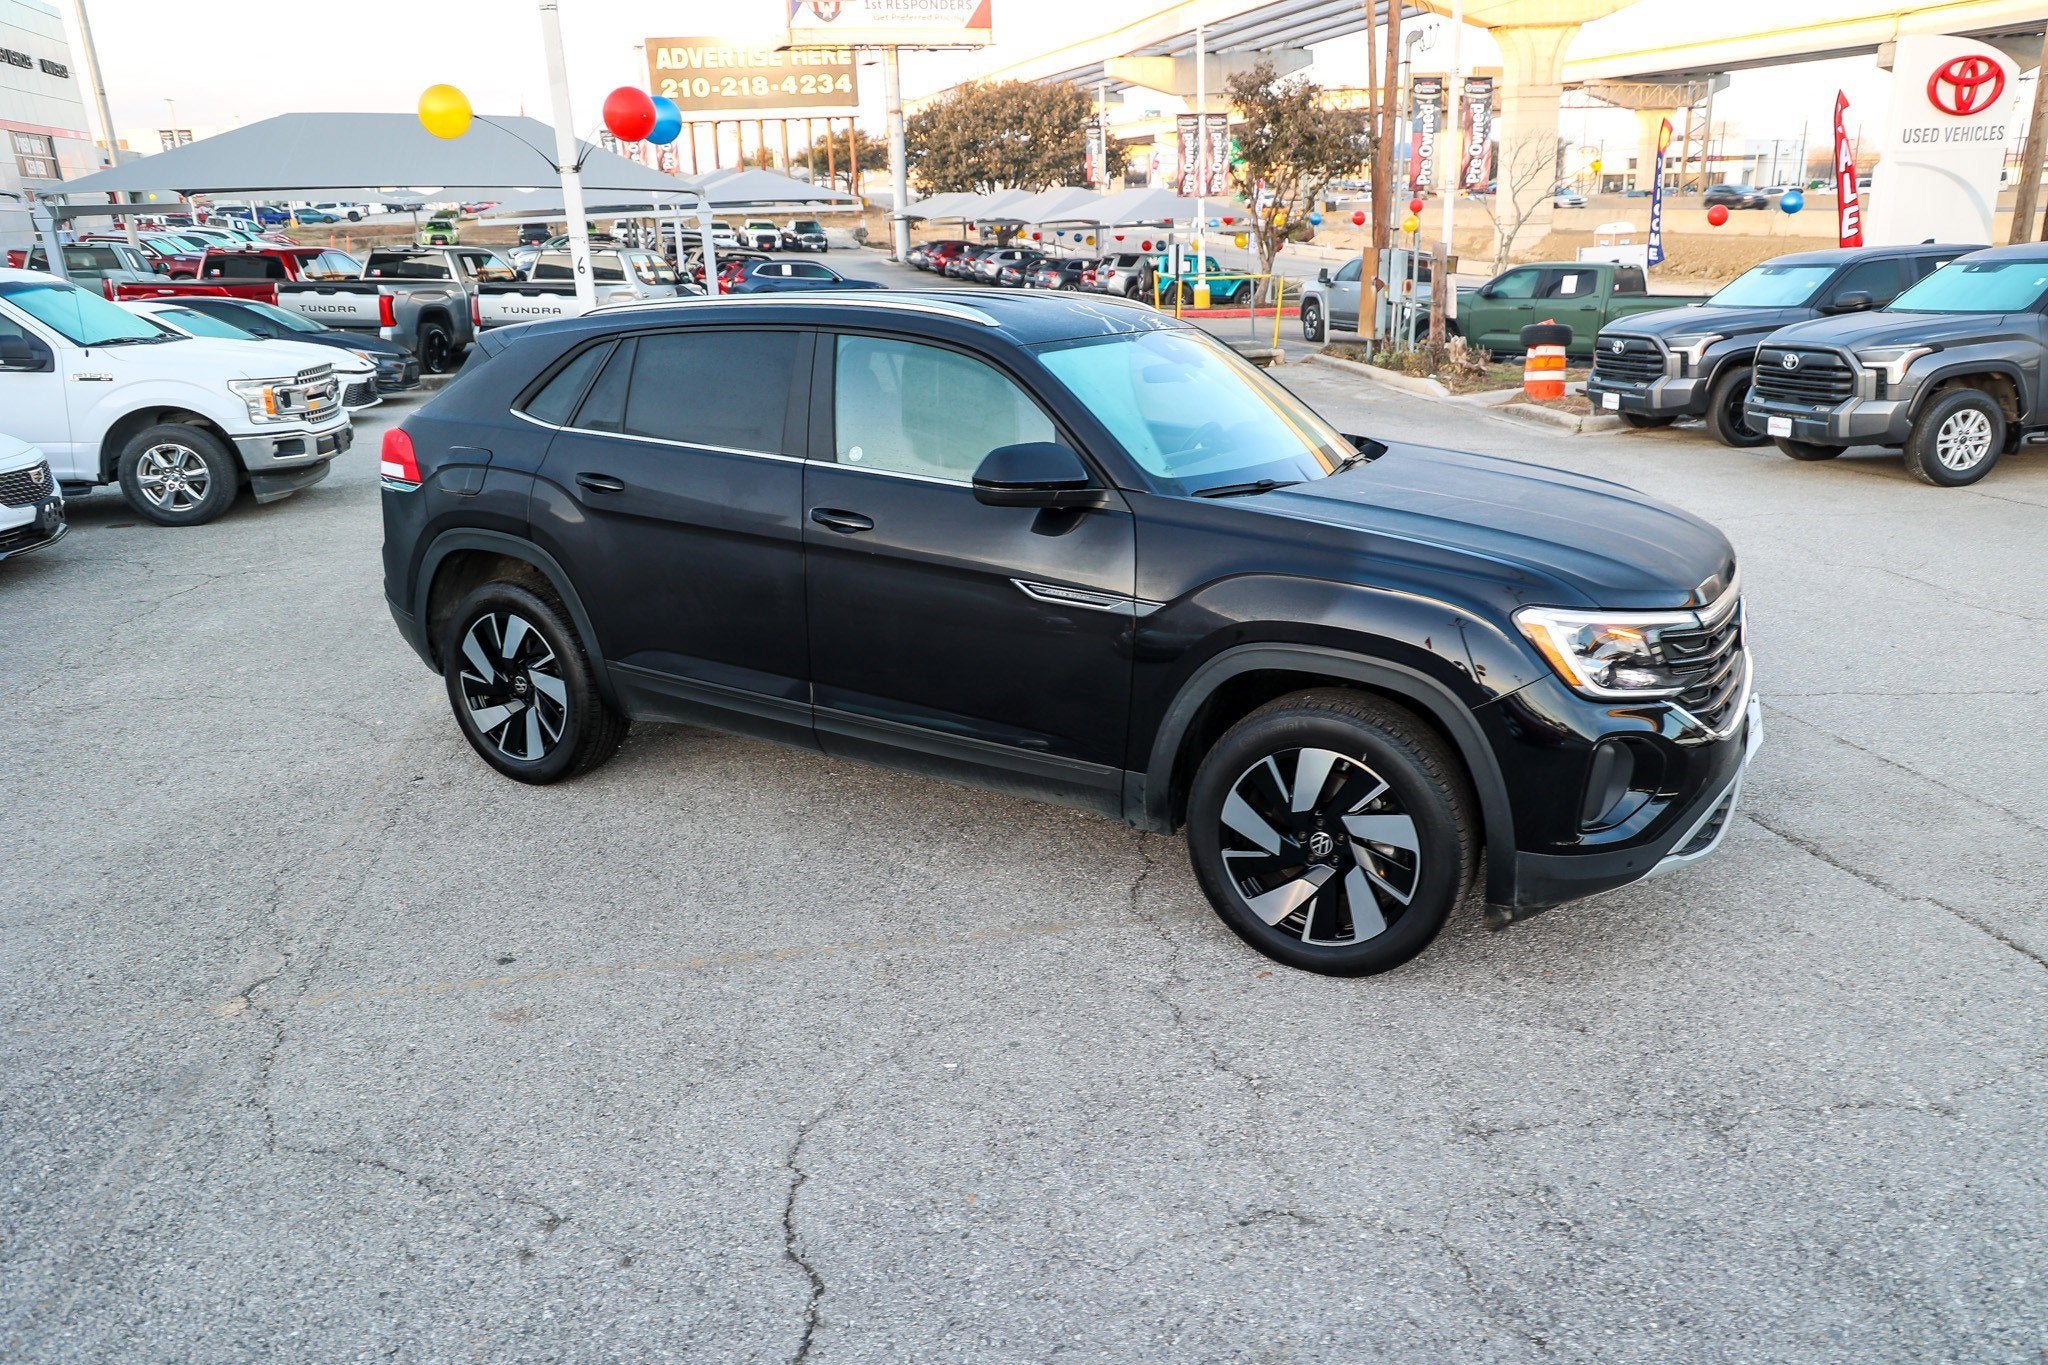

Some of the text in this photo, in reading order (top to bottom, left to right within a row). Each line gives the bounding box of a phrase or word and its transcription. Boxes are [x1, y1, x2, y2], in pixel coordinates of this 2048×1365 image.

[865, 0, 973, 10] 1st RESPONDERS
[655, 46, 853, 70] ADVERTISE HERE
[659, 73, 853, 99] 210-218-4234
[1418, 103, 1435, 158] Owned
[1468, 103, 1485, 157] Owned
[1902, 125, 2006, 143] USED VEHICLES
[1181, 132, 1195, 173] Owned
[1210, 132, 1223, 173] Owned
[1182, 173, 1194, 193] Pre
[1210, 173, 1222, 193] Pre
[1415, 159, 1432, 186] Pre
[1465, 158, 1482, 184] Pre
[576, 256, 586, 275] 6
[298, 304, 357, 314] TUNDRA
[501, 305, 563, 315] TUNDRA
